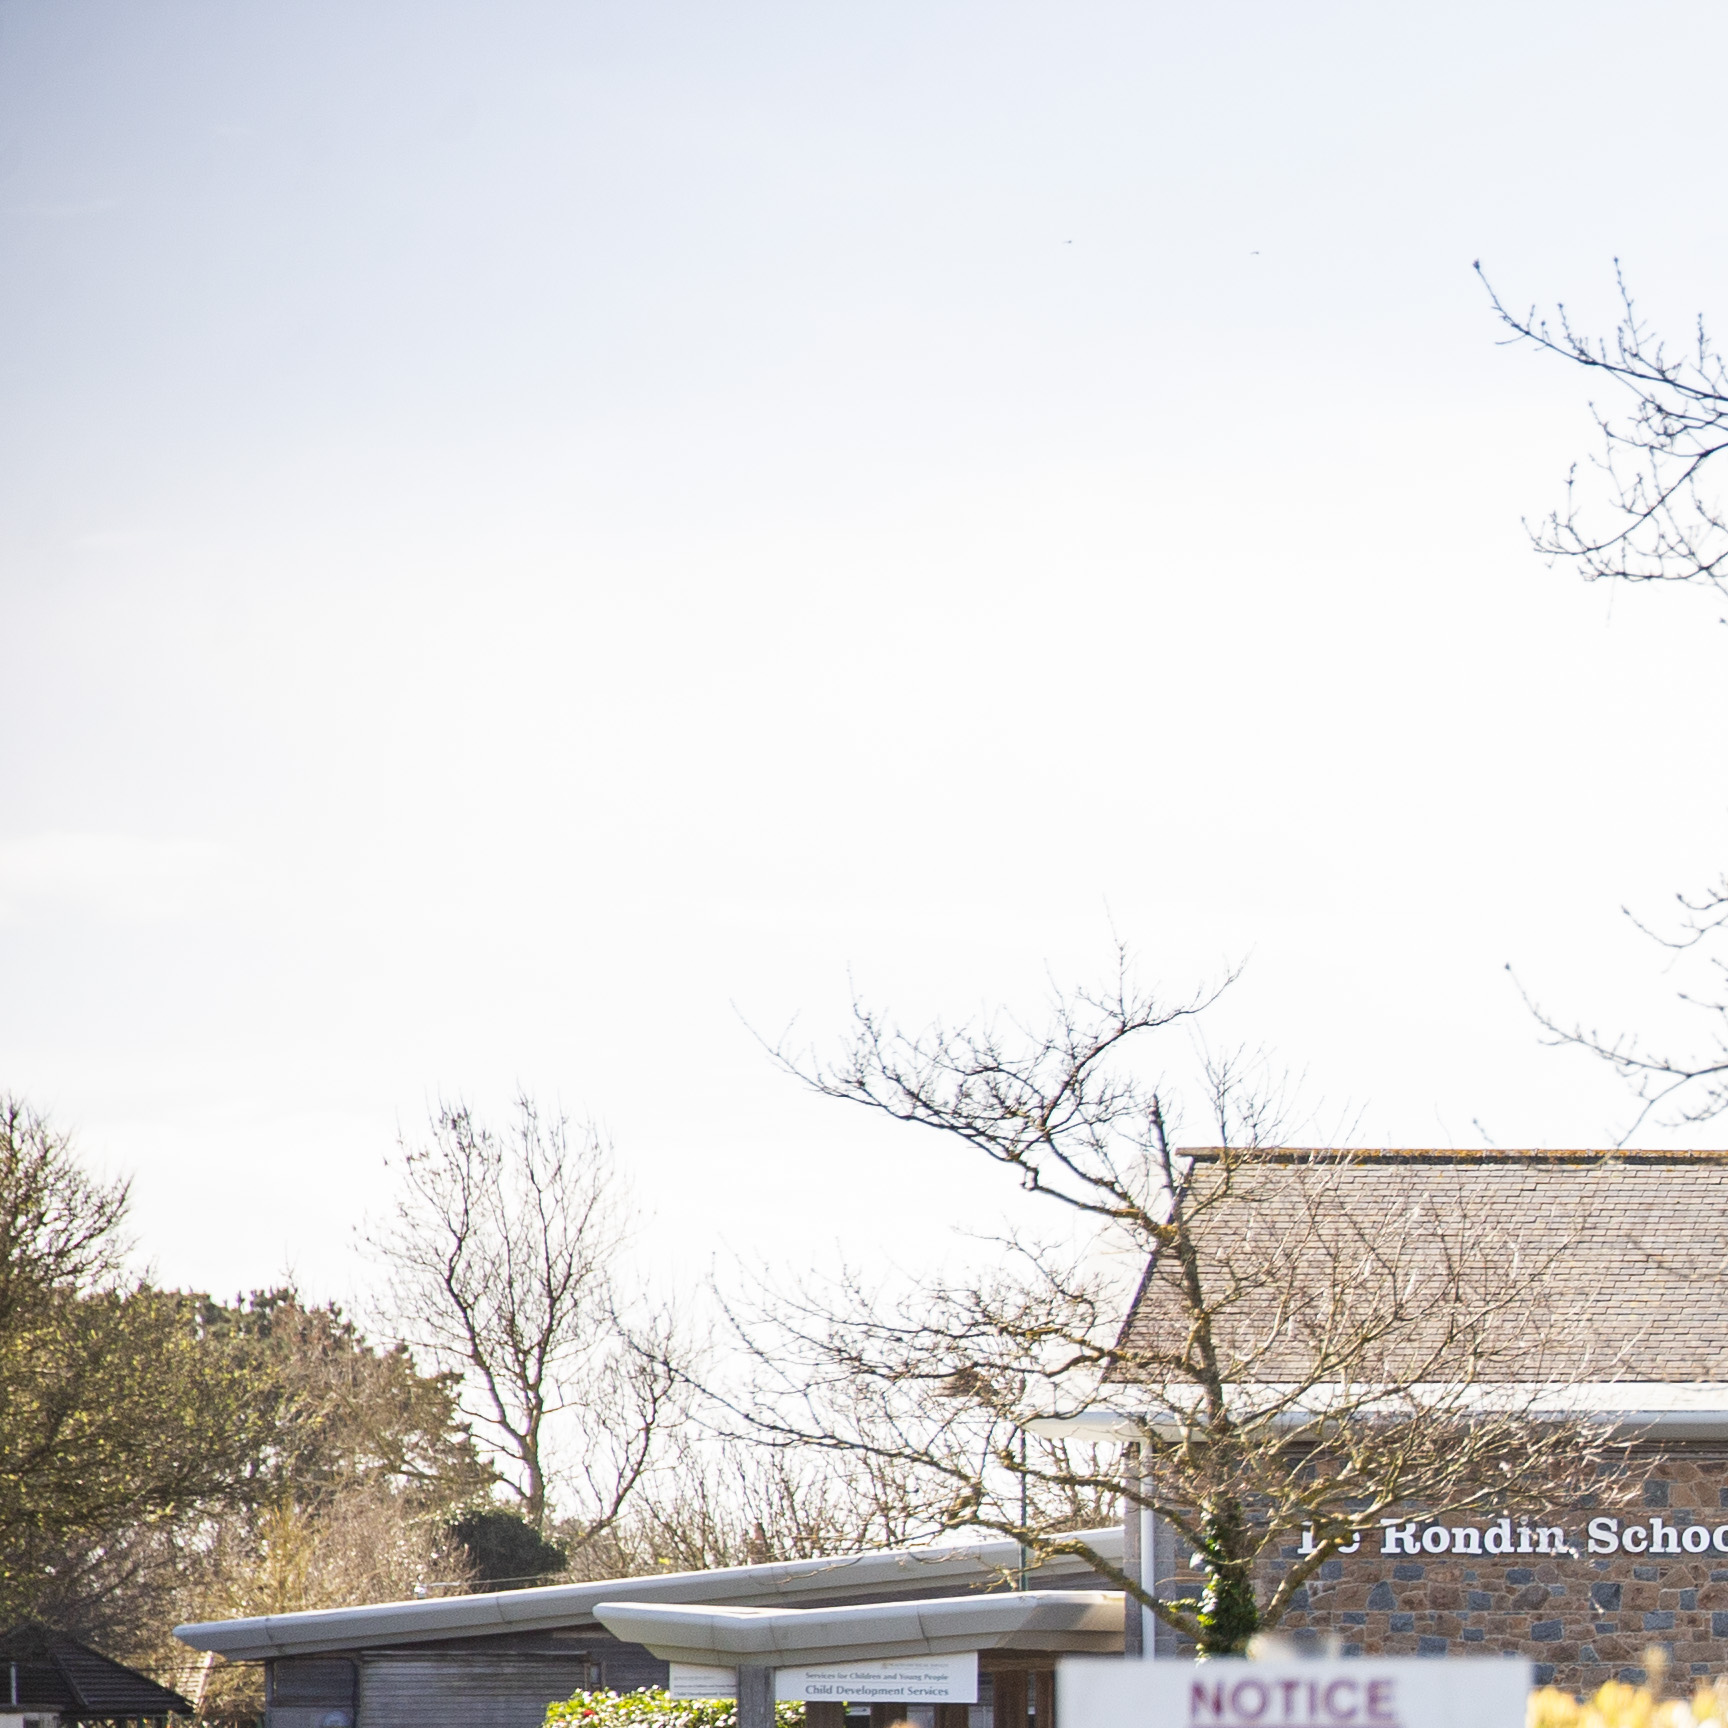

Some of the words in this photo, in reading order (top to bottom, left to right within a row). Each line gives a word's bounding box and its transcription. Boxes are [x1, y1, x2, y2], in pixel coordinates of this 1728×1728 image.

[1380, 1517, 1569, 1555] Rondin
[805, 1672, 835, 1680] Services
[837, 1672, 848, 1680] for
[849, 1672, 881, 1680] Children
[883, 1673, 897, 1681] and
[899, 1674, 922, 1682] Young
[924, 1674, 949, 1682] People
[805, 1685, 833, 1695] Child
[836, 1685, 905, 1697] Development
[907, 1686, 949, 1696] Services
[1187, 1678, 1399, 1721] NOTICE
